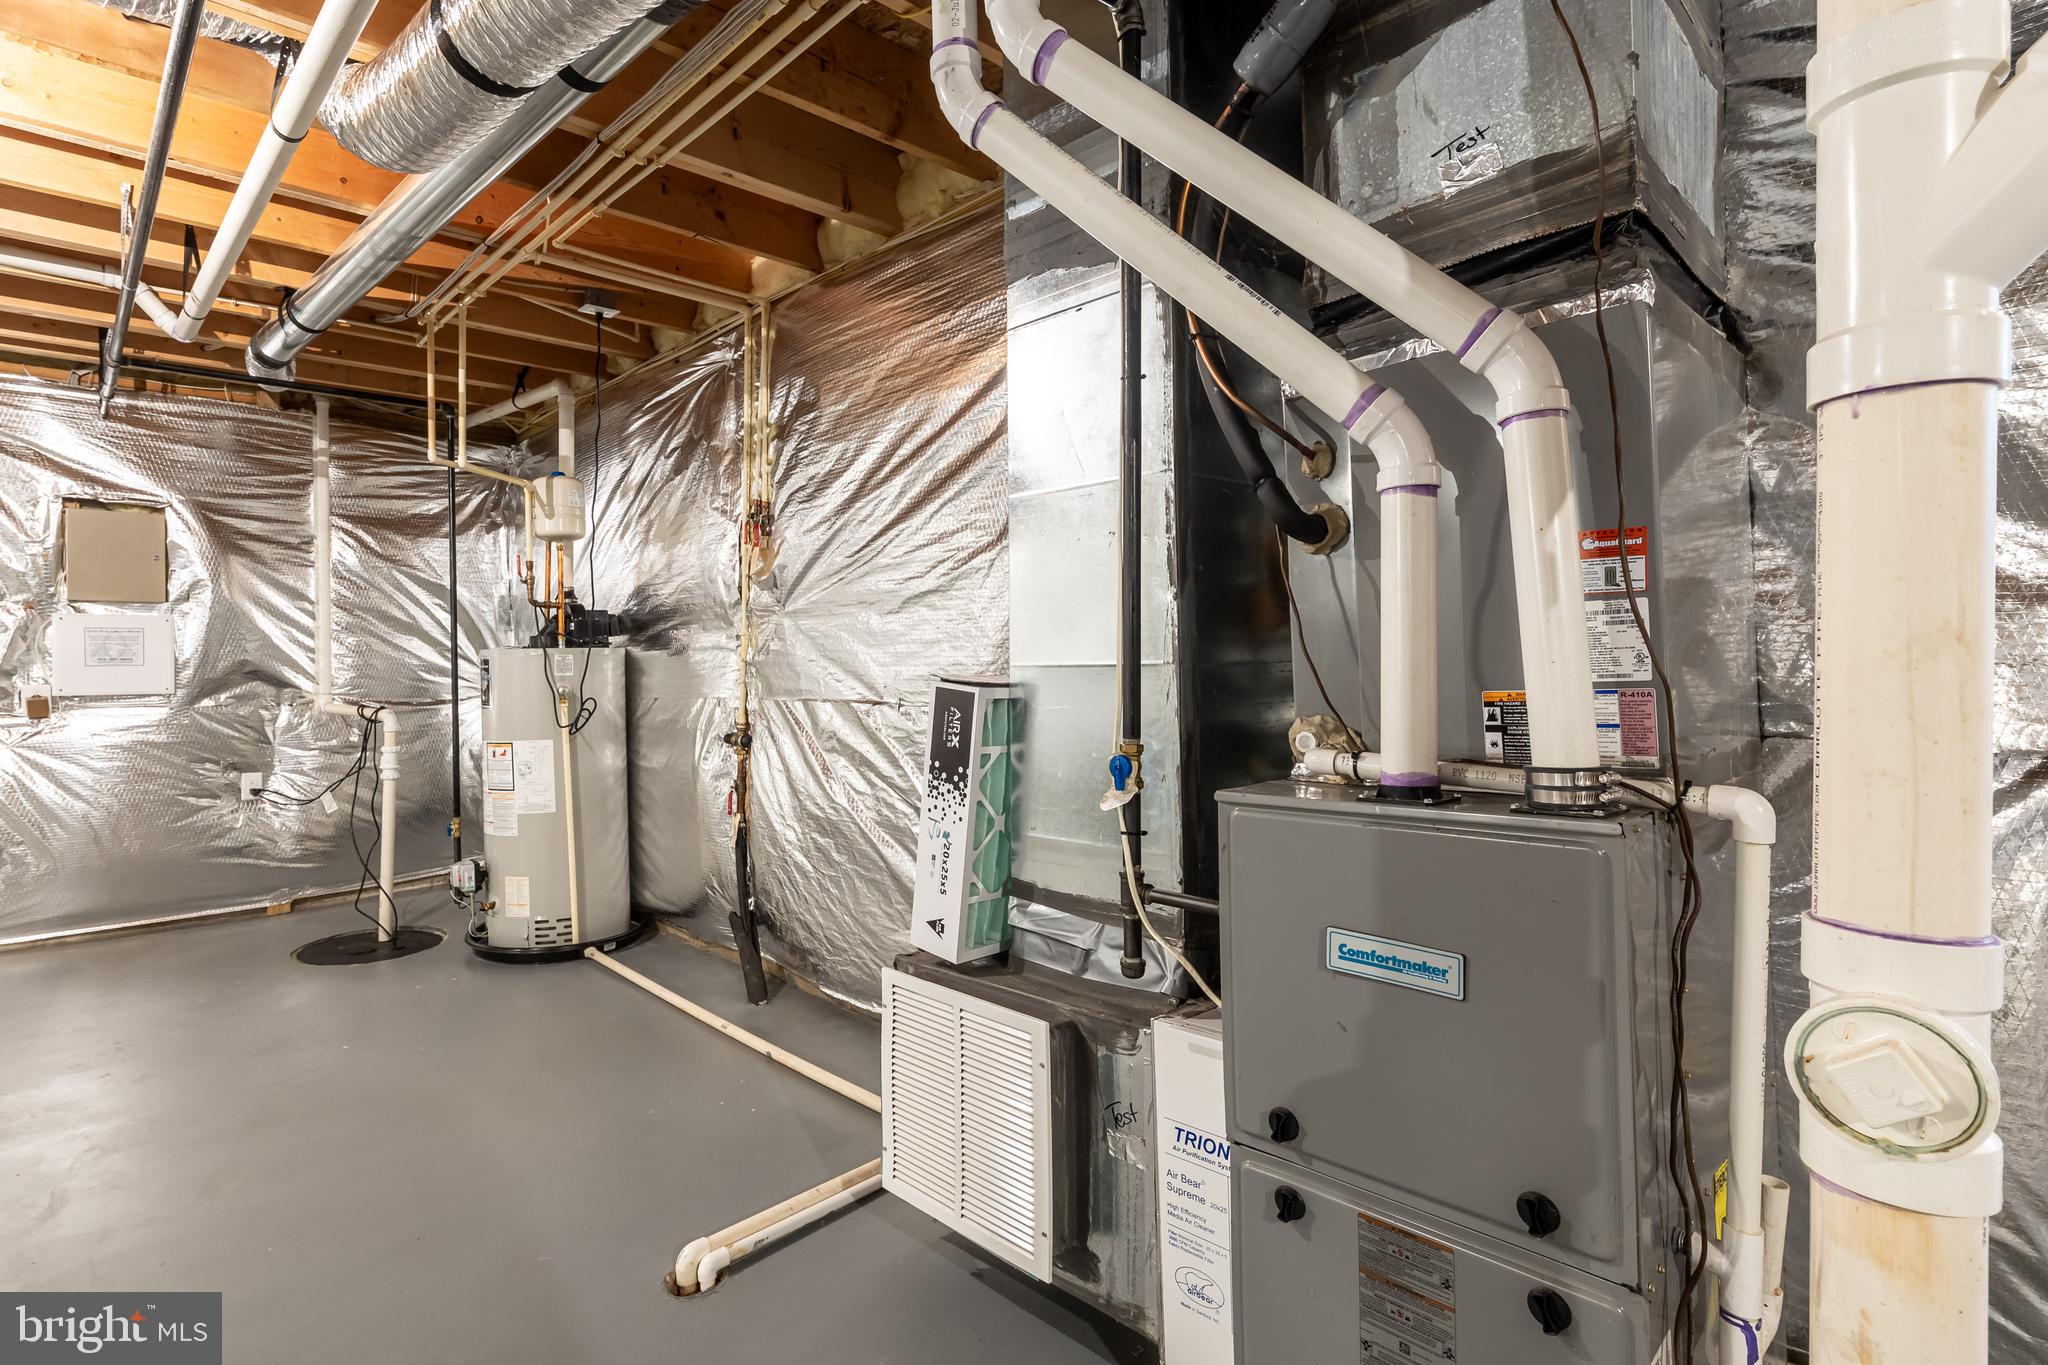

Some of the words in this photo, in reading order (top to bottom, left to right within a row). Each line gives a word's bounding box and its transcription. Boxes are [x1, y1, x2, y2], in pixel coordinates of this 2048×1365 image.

[1430, 125, 1491, 160] Test
[1620, 691, 1653, 699] R-410A
[1453, 767, 1469, 778] PVC
[940, 842, 951, 896] 20x25x5
[1338, 943, 1449, 978] Comfortmaker
[1104, 1101, 1138, 1129] Test
[1172, 1144, 1181, 1153] Air
[1182, 1148, 1216, 1166] Purification
[1174, 1126, 1231, 1161] TRION
[1166, 1168, 1179, 1180] Air
[1166, 1181, 1206, 1205] Supreme
[1167, 1201, 1180, 1211] High
[1180, 1206, 1207, 1223] Efficiency
[1167, 1209, 1184, 1221] Media
[1184, 1217, 1193, 1225] Air
[1193, 1220, 1215, 1235] Cleaner
